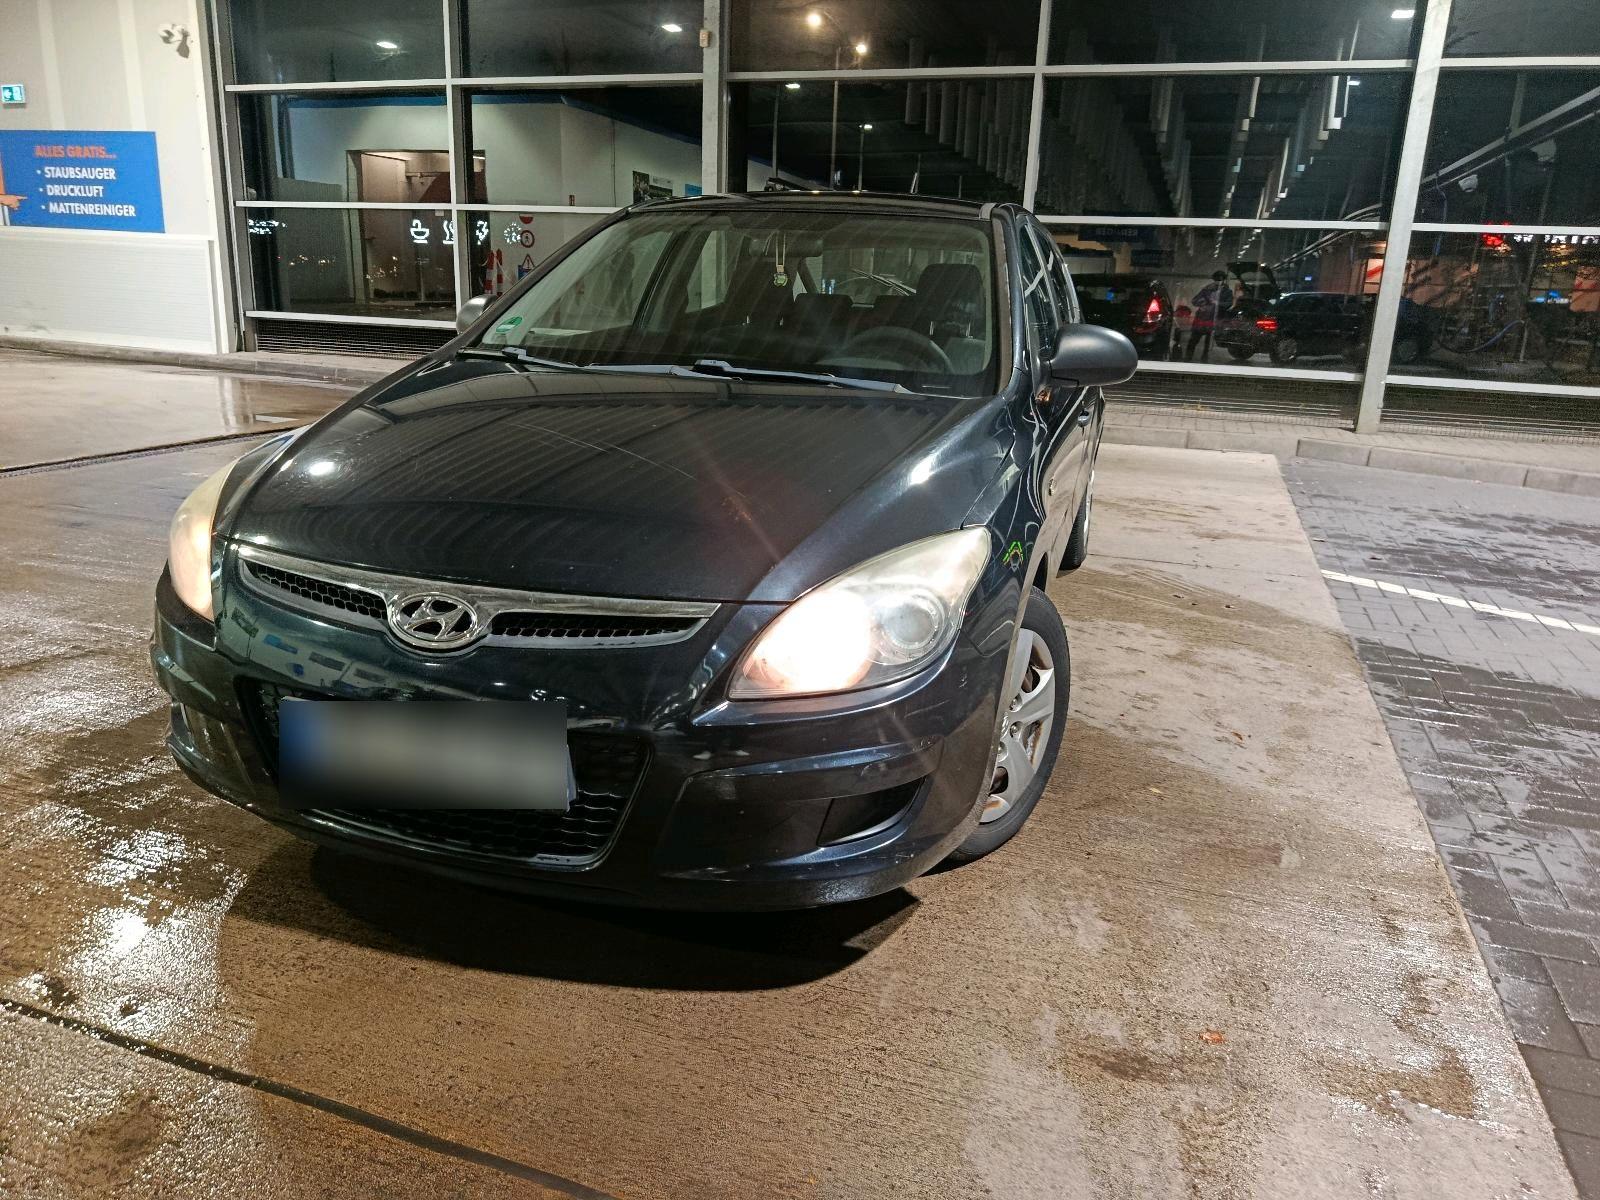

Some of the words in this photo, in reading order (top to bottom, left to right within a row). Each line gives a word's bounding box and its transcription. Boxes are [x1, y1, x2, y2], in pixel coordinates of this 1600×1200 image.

[35, 145, 65, 158] ALLES
[44, 166, 116, 180] STAUBSAUGER
[46, 185, 104, 198] DRUCKLUFT
[49, 203, 136, 217] MATTENREINIGER
